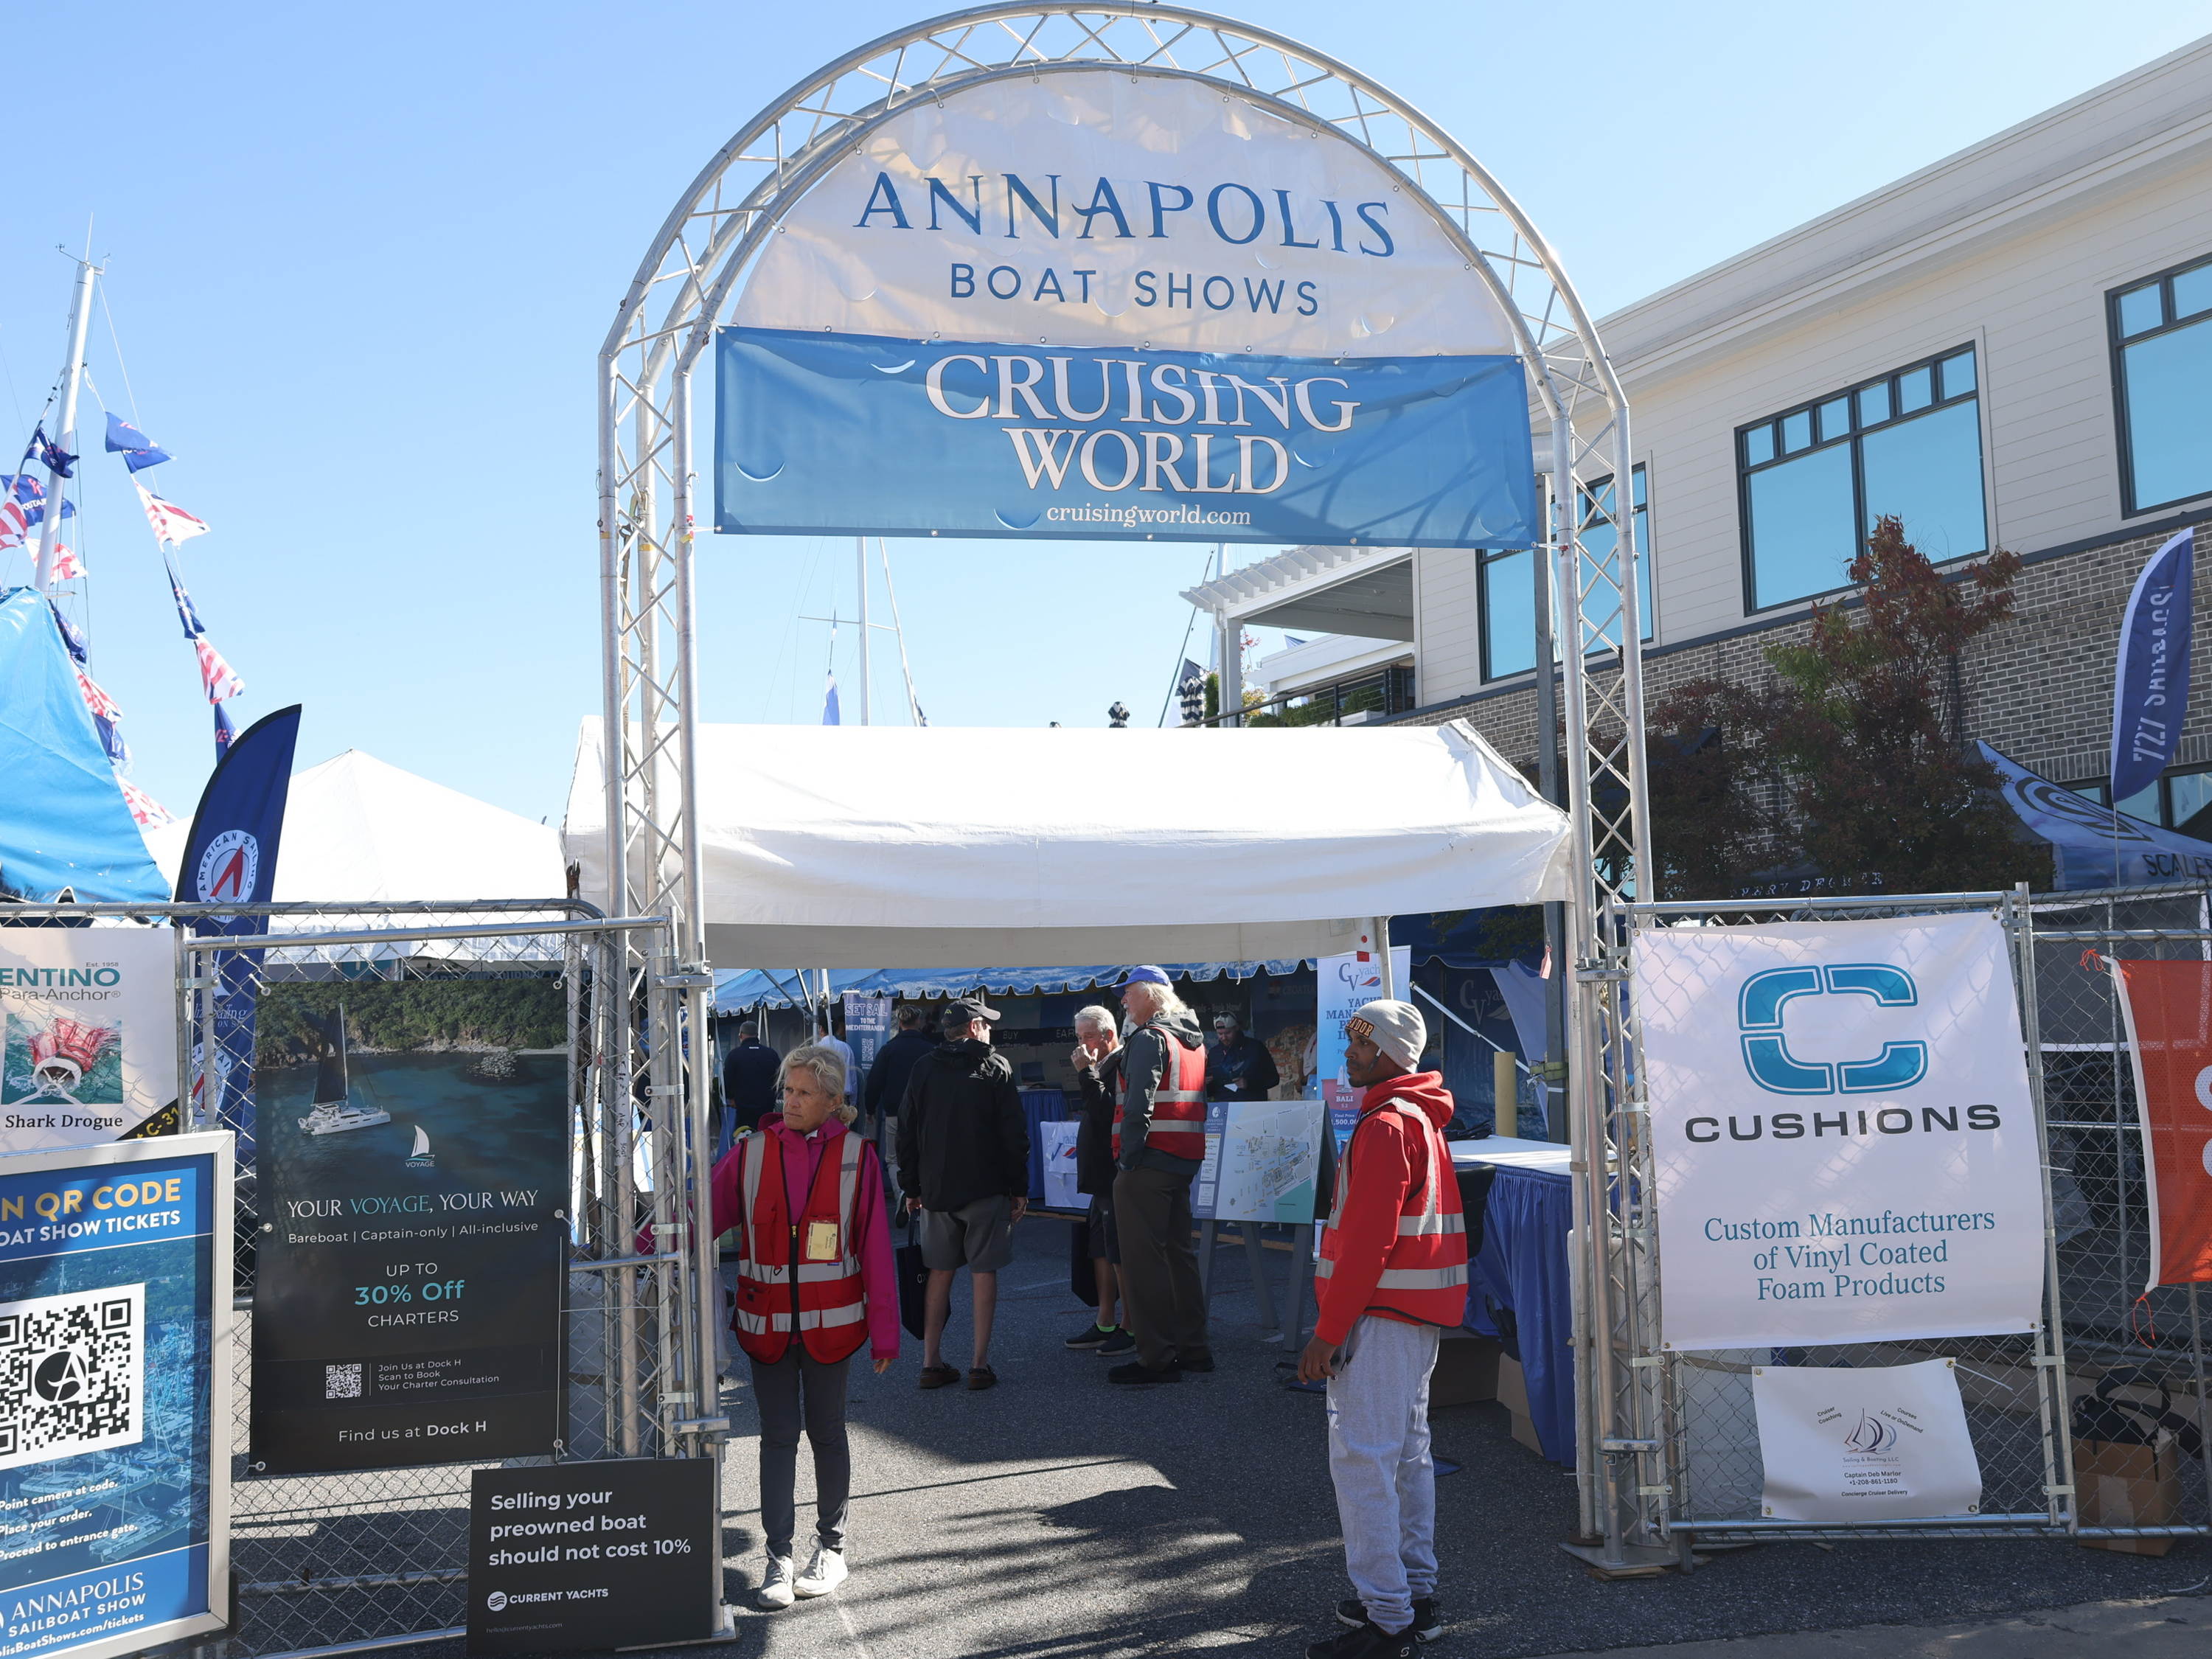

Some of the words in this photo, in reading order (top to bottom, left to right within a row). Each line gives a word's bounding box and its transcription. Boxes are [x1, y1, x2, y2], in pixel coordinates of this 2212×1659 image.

[853, 171, 1395, 258] ANNAPOLIS
[951, 263, 1096, 303] BOAT
[1134, 270, 1318, 316] SHOWS
[925, 355, 1361, 432] CRUISING
[1001, 427, 1290, 495] WORLD
[1046, 503, 1251, 528] cruisingworld.com
[2132, 717, 2166, 762] 727
[199, 832, 237, 891] AMERICAN
[0, 967, 121, 987] ENTINO
[845, 1003, 866, 1016] SET
[1056, 1029, 1076, 1038] EAR
[5, 1115, 56, 1128] Shark
[61, 1115, 123, 1130] Drogue
[1685, 1104, 2001, 1143] CUSHIONS
[405, 1160, 435, 1168] VOYAGE
[35, 1189, 83, 1222] QR
[92, 1178, 181, 1210] CODE
[287, 1199, 342, 1218] YOUR
[349, 1194, 434, 1215] VOYAGE,
[439, 1192, 493, 1211] YOUR
[500, 1189, 539, 1208] WAY
[40, 1220, 101, 1242] SHOW
[105, 1210, 181, 1233] TICKETS
[288, 1231, 348, 1244] Bareboat
[361, 1225, 448, 1242] Captain-only
[459, 1220, 539, 1235] All-inclusive
[1704, 1217, 1801, 1242] Custom
[1809, 1209, 1995, 1238] Manufacturers
[386, 1264, 410, 1277] UP
[415, 1262, 438, 1276] TO
[1753, 1248, 1778, 1270] of
[1784, 1243, 1851, 1274] Vinyl
[1860, 1239, 1948, 1266] Coated
[354, 1283, 412, 1305] 30%
[422, 1279, 466, 1301] Off
[1757, 1276, 1826, 1301] Foam
[1834, 1272, 1946, 1298] Products
[367, 1310, 459, 1328] CHARTERS
[378, 1364, 398, 1373] Join
[401, 1363, 413, 1371] Us
[416, 1362, 425, 1370] at
[427, 1360, 451, 1368] Dock
[378, 1373, 400, 1382] Scan
[403, 1372, 414, 1380] to
[417, 1370, 441, 1379] Book
[378, 1382, 400, 1391] Your
[402, 1380, 438, 1390] Charter
[440, 1375, 500, 1387] Consultation
[1817, 1406, 1835, 1416] Cruiser
[1818, 1412, 1843, 1425] Coaching
[1880, 1409, 1891, 1419] Live
[1897, 1417, 1924, 1433] OnDemand
[1897, 1407, 1917, 1420] Courses
[338, 1429, 375, 1442] Find
[380, 1428, 400, 1439] us
[405, 1427, 421, 1438] at
[427, 1422, 470, 1436] Dock
[476, 1420, 487, 1433] H
[0, 1497, 29, 1511] Point
[31, 1489, 73, 1506] camera
[75, 1486, 87, 1496] at
[89, 1478, 119, 1492] code.
[490, 1491, 561, 1512] Selling
[566, 1490, 613, 1509] your
[0, 1520, 28, 1536] Place
[29, 1517, 58, 1534] your
[59, 1510, 93, 1524] order.
[490, 1515, 594, 1542] preowned
[601, 1514, 647, 1531] boat
[45, 1540, 58, 1551] to
[60, 1531, 109, 1547] entrance
[111, 1523, 139, 1540] gate.
[489, 1545, 559, 1566] should
[566, 1543, 600, 1561] not
[605, 1541, 648, 1557] cost
[653, 1538, 691, 1555] 10%
[12, 1572, 145, 1621] ANNAPOLIS
[509, 1591, 563, 1604] CURRENT
[566, 1588, 609, 1600] YACHTS
[8, 1607, 91, 1638] SAILBOAT
[97, 1593, 147, 1615] SHOW
